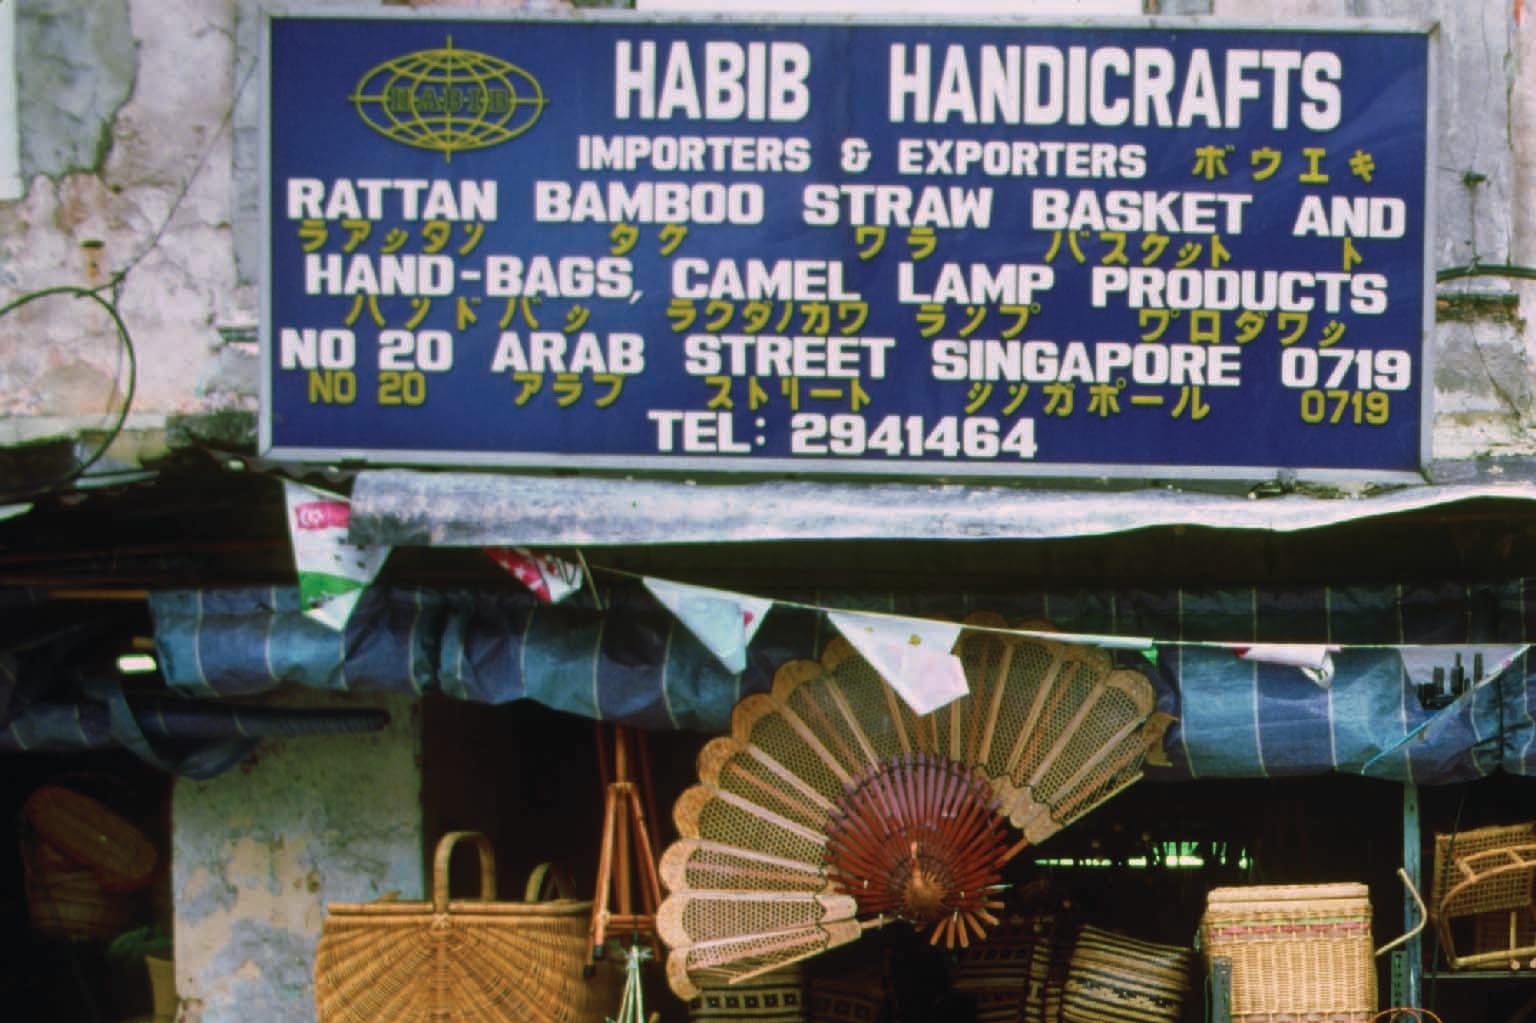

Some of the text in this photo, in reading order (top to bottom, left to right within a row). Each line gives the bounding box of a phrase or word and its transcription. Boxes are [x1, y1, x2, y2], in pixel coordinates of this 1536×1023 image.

[615, 40, 1342, 130] HABIB HANDICRAFTS
[578, 135, 1146, 178] IMPORTERS & EXPORTERS
[287, 178, 1406, 238] RATTAN BAMBOO STRAW BASKET AND
[854, 226, 937, 260] ワラ
[306, 253, 1387, 314] HAND-BAGS, CAMEL LAMP PRODUCTS
[915, 303, 1040, 339] ランプ
[281, 328, 1411, 390] NO 20 ARAB STREET SINGAPORE 0719
[308, 367, 357, 403] NO
[377, 368, 426, 405] 20
[704, 375, 871, 411] ストリート
[964, 379, 1210, 419] シンガポール
[1300, 388, 1390, 425] 0719
[647, 410, 1038, 458] TEL: 2941464
